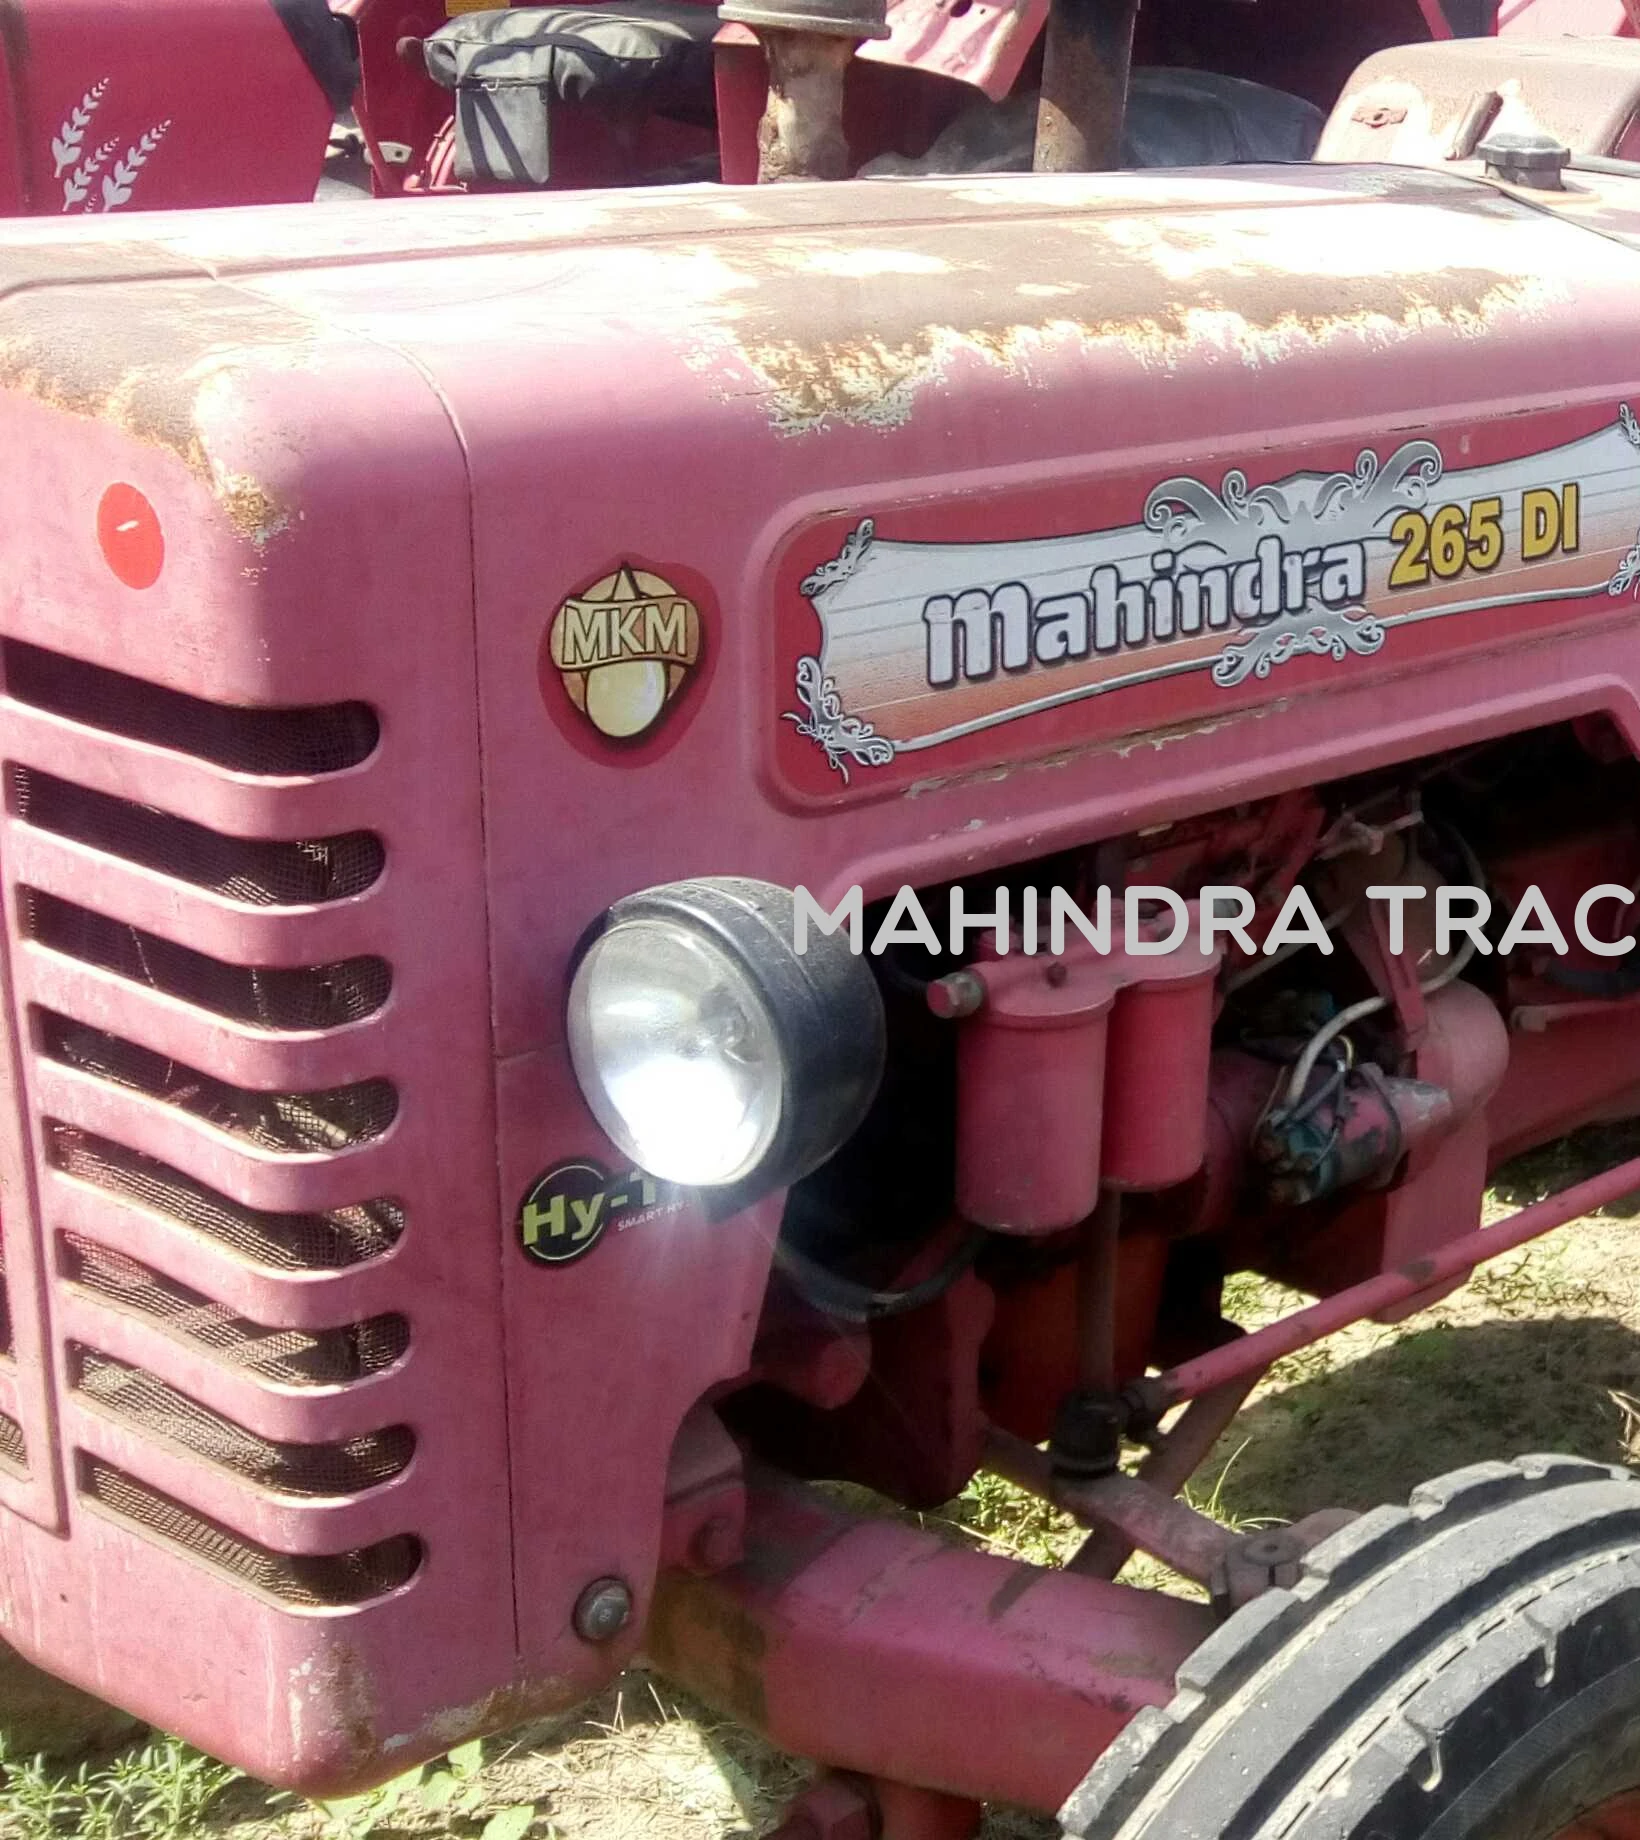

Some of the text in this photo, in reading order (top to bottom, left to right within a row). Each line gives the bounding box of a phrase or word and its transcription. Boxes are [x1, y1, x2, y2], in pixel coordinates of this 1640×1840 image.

[922, 483, 1579, 686] Mahindra 265 DI
[561, 602, 688, 666] MKM
[522, 1170, 657, 1246] Hy-T
